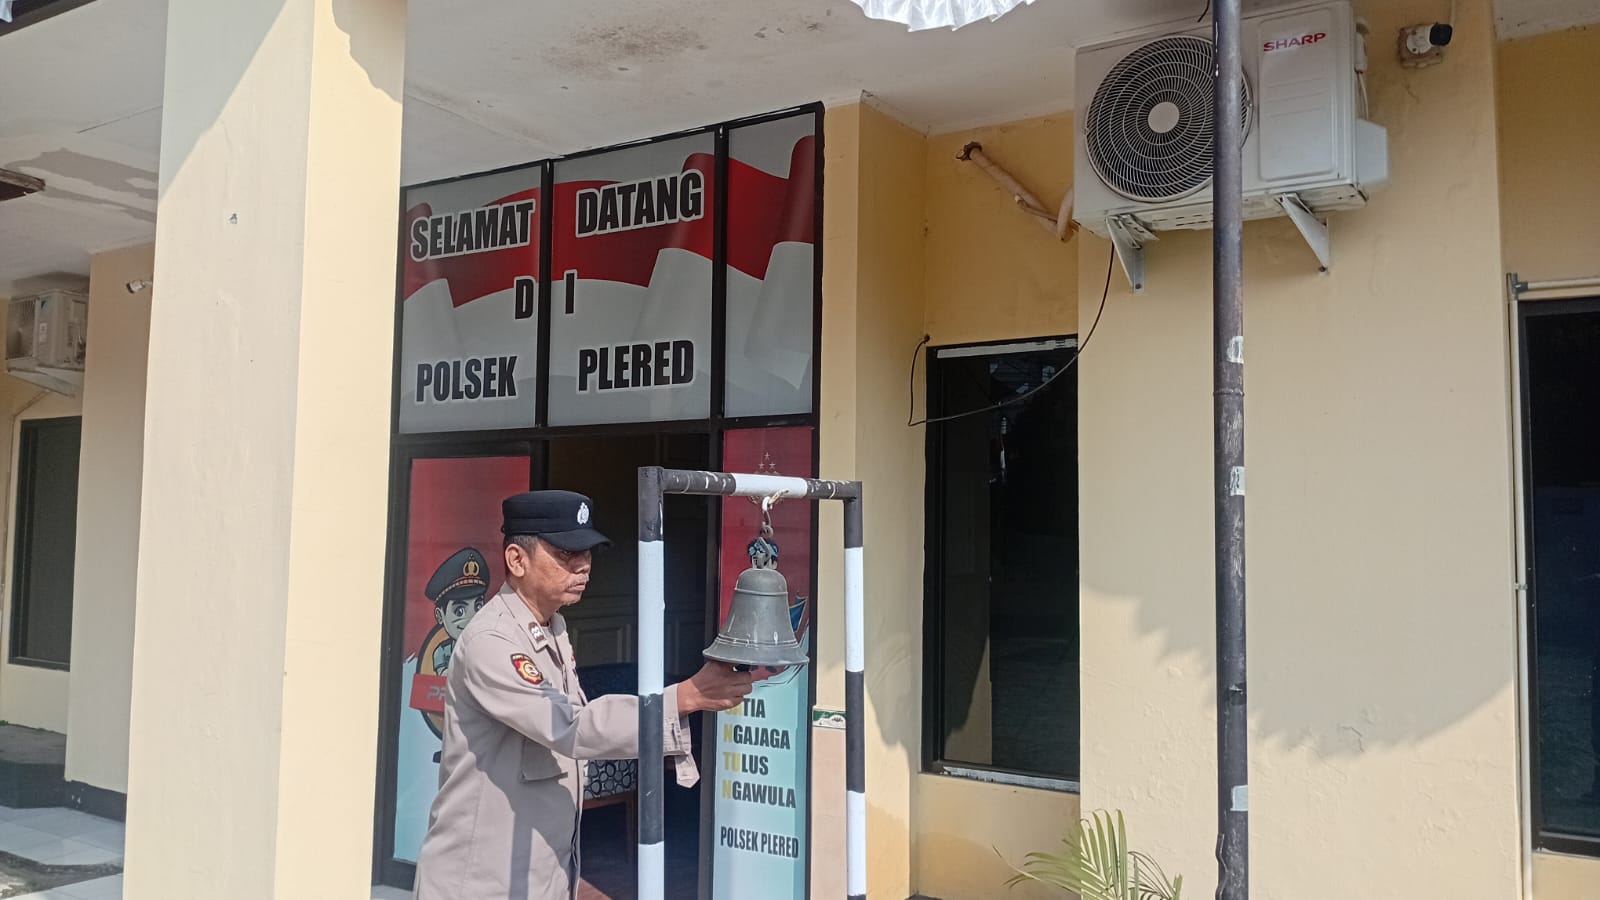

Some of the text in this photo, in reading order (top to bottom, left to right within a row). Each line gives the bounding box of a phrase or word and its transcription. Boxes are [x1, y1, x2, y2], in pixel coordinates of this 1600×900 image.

[1263, 32, 1326, 52] SHARP
[410, 171, 703, 260] SELAMAT DATANG
[416, 340, 694, 402] POLSEK PLERED
[723, 723, 791, 750] NGAJAGA
[723, 751, 769, 776] TULUS
[721, 779, 796, 809] NGAWULA
[720, 826, 799, 858] POLSEK PLERED
